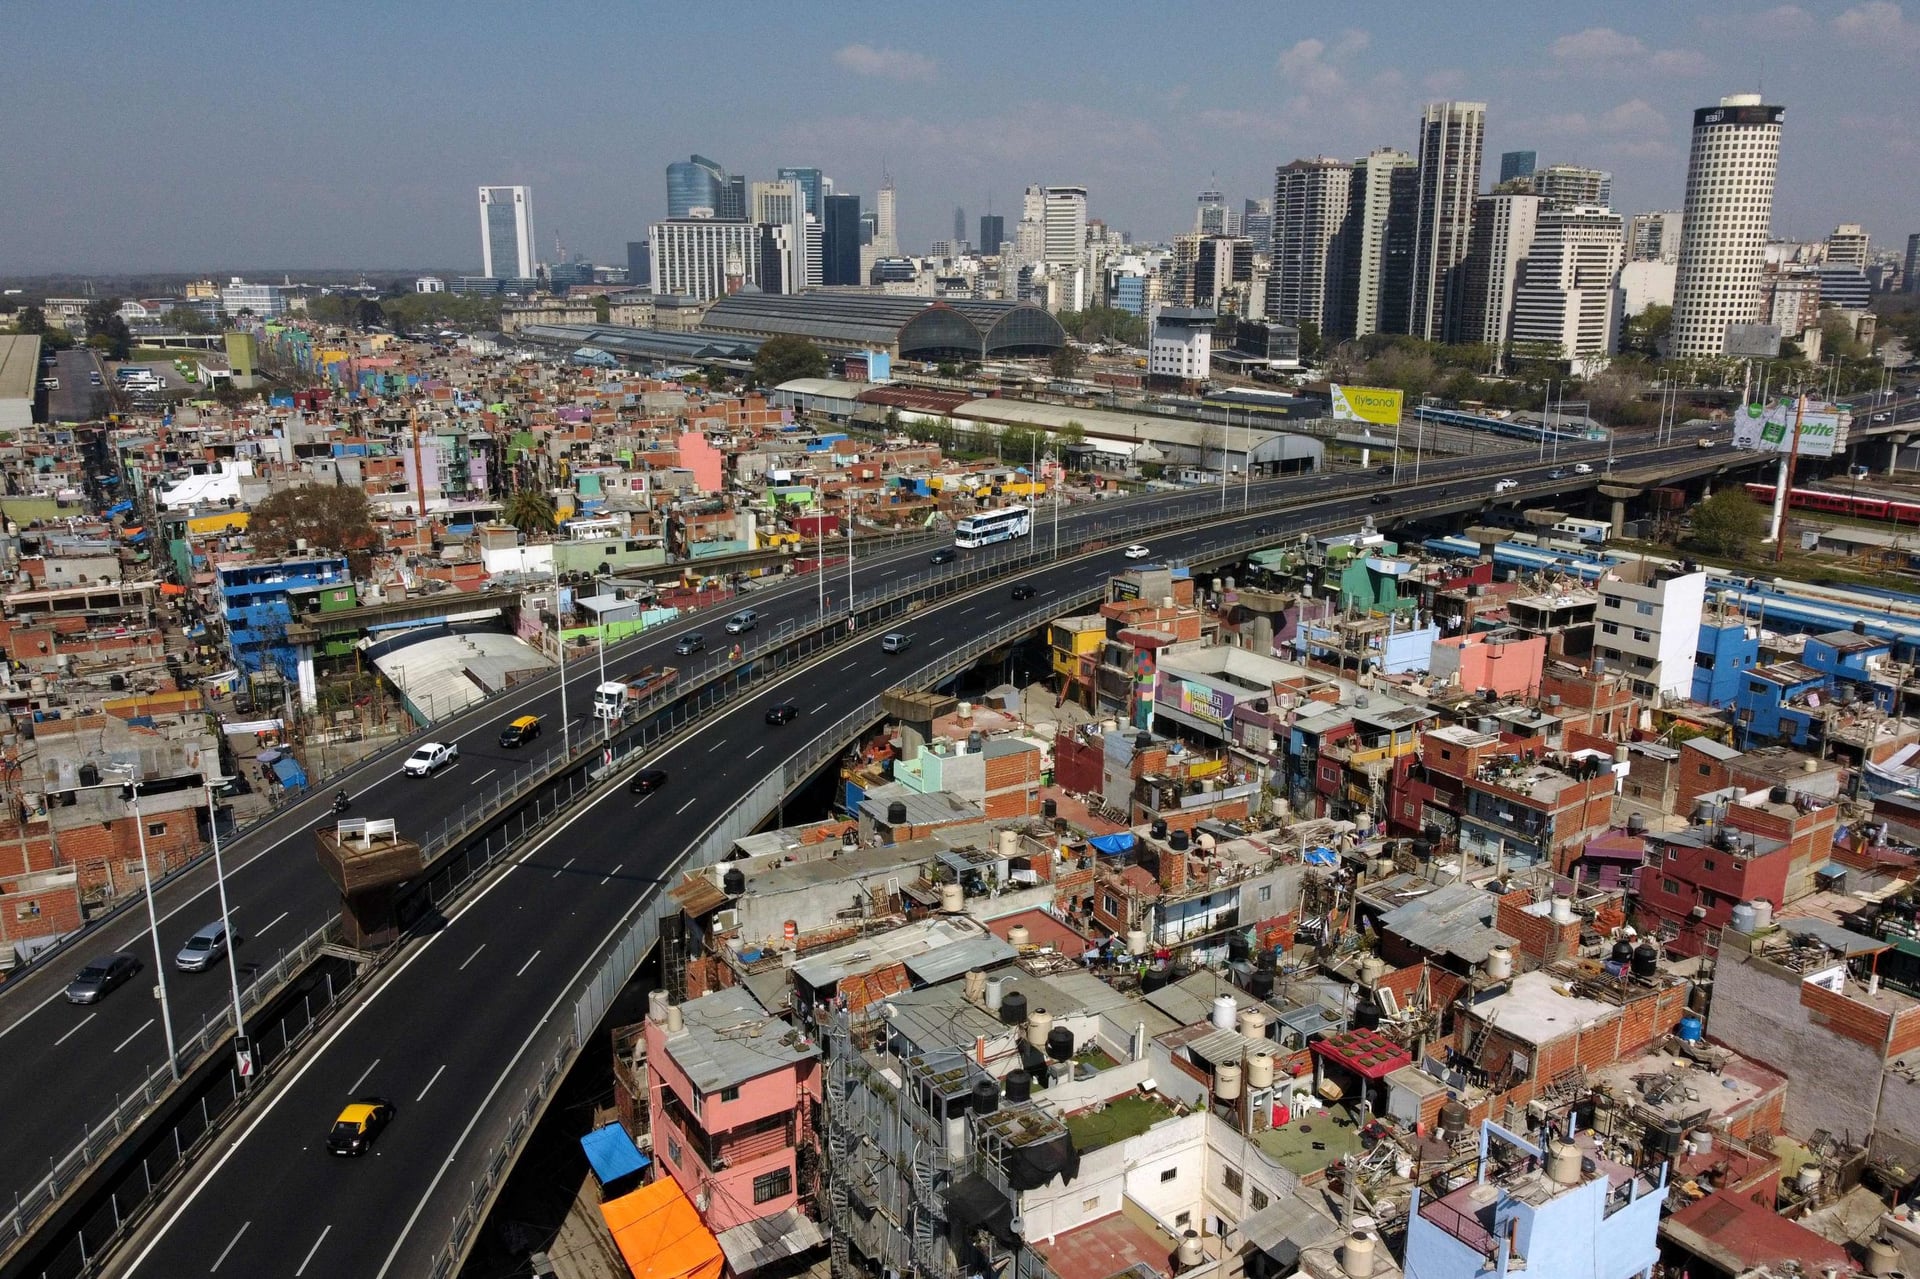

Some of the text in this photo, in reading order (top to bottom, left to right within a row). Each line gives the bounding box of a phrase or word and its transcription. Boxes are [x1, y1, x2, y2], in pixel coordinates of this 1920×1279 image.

[1355, 394, 1394, 408] flybondi
[1791, 422, 1834, 437] prite
[1193, 701, 1220, 719] CULTURA
